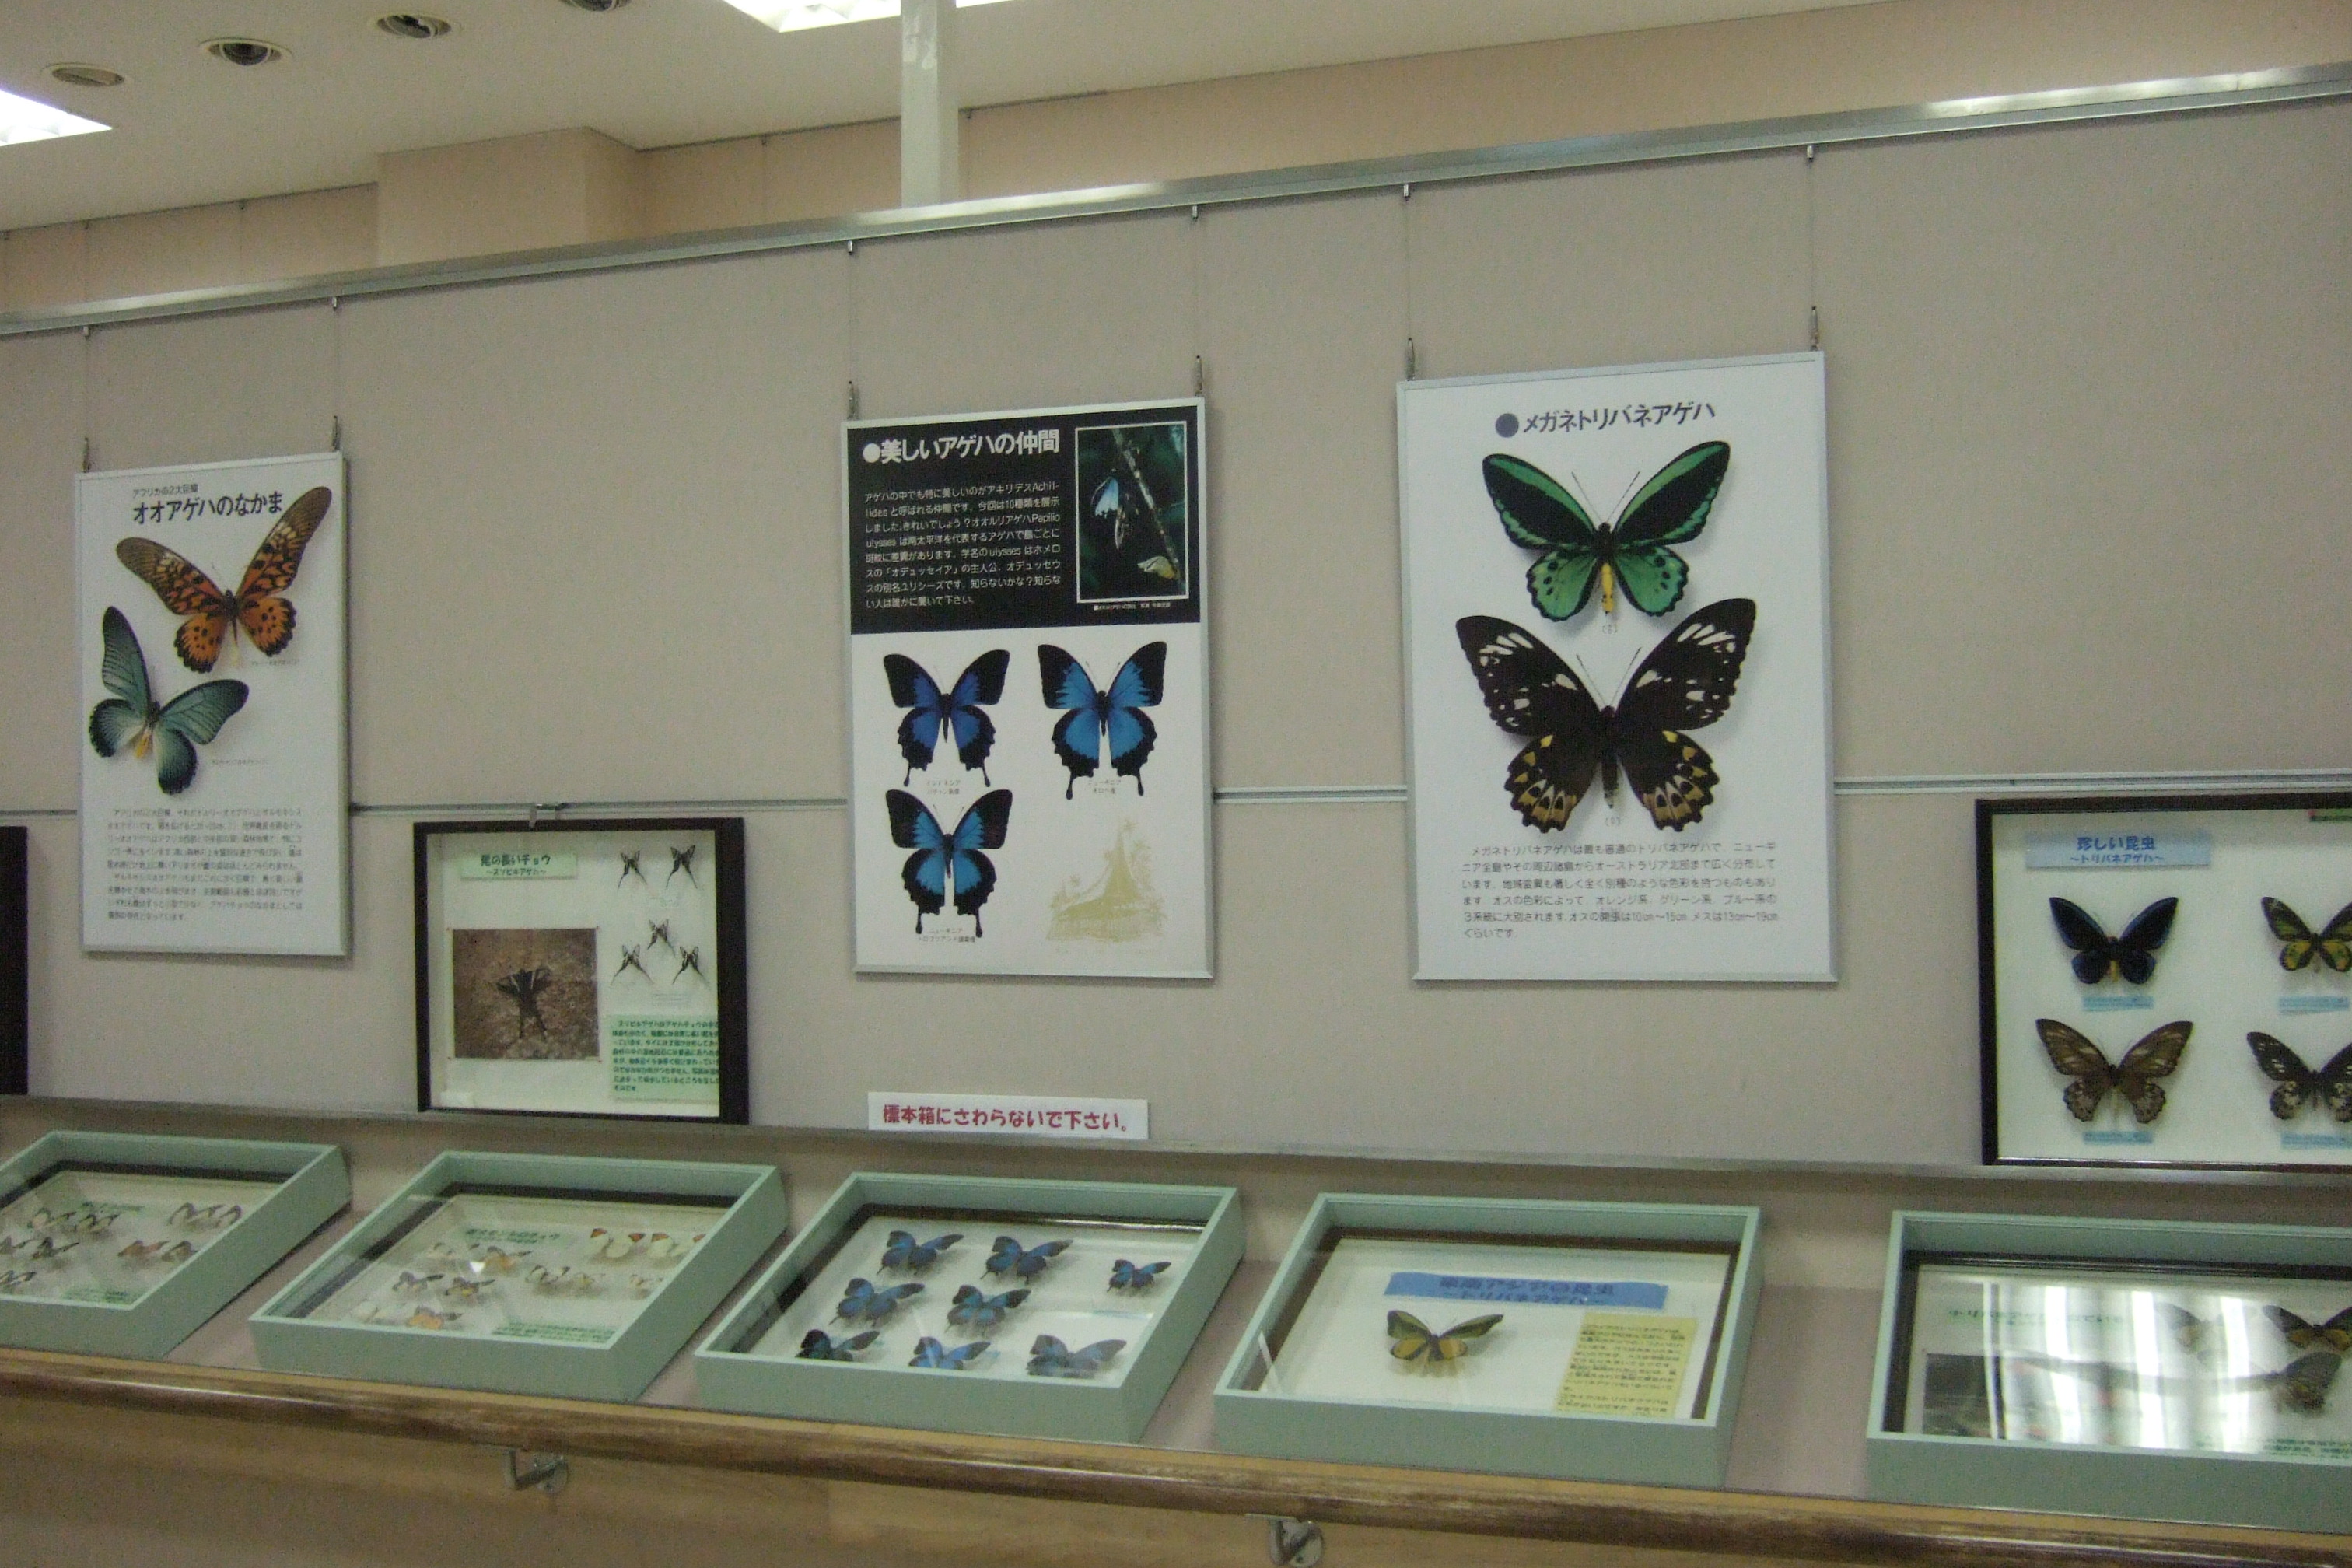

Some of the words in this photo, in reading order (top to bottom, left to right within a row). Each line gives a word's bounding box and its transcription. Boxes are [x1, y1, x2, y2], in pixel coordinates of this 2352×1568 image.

[1524, 401, 1716, 433] メガネトリバネアゲハ
[133, 490, 283, 525] オオアゲハのなかま
[2076, 835, 2157, 851] 珍しい昆虫
[883, 1104, 1127, 1132] 標本箱にさわらないで下さい。
